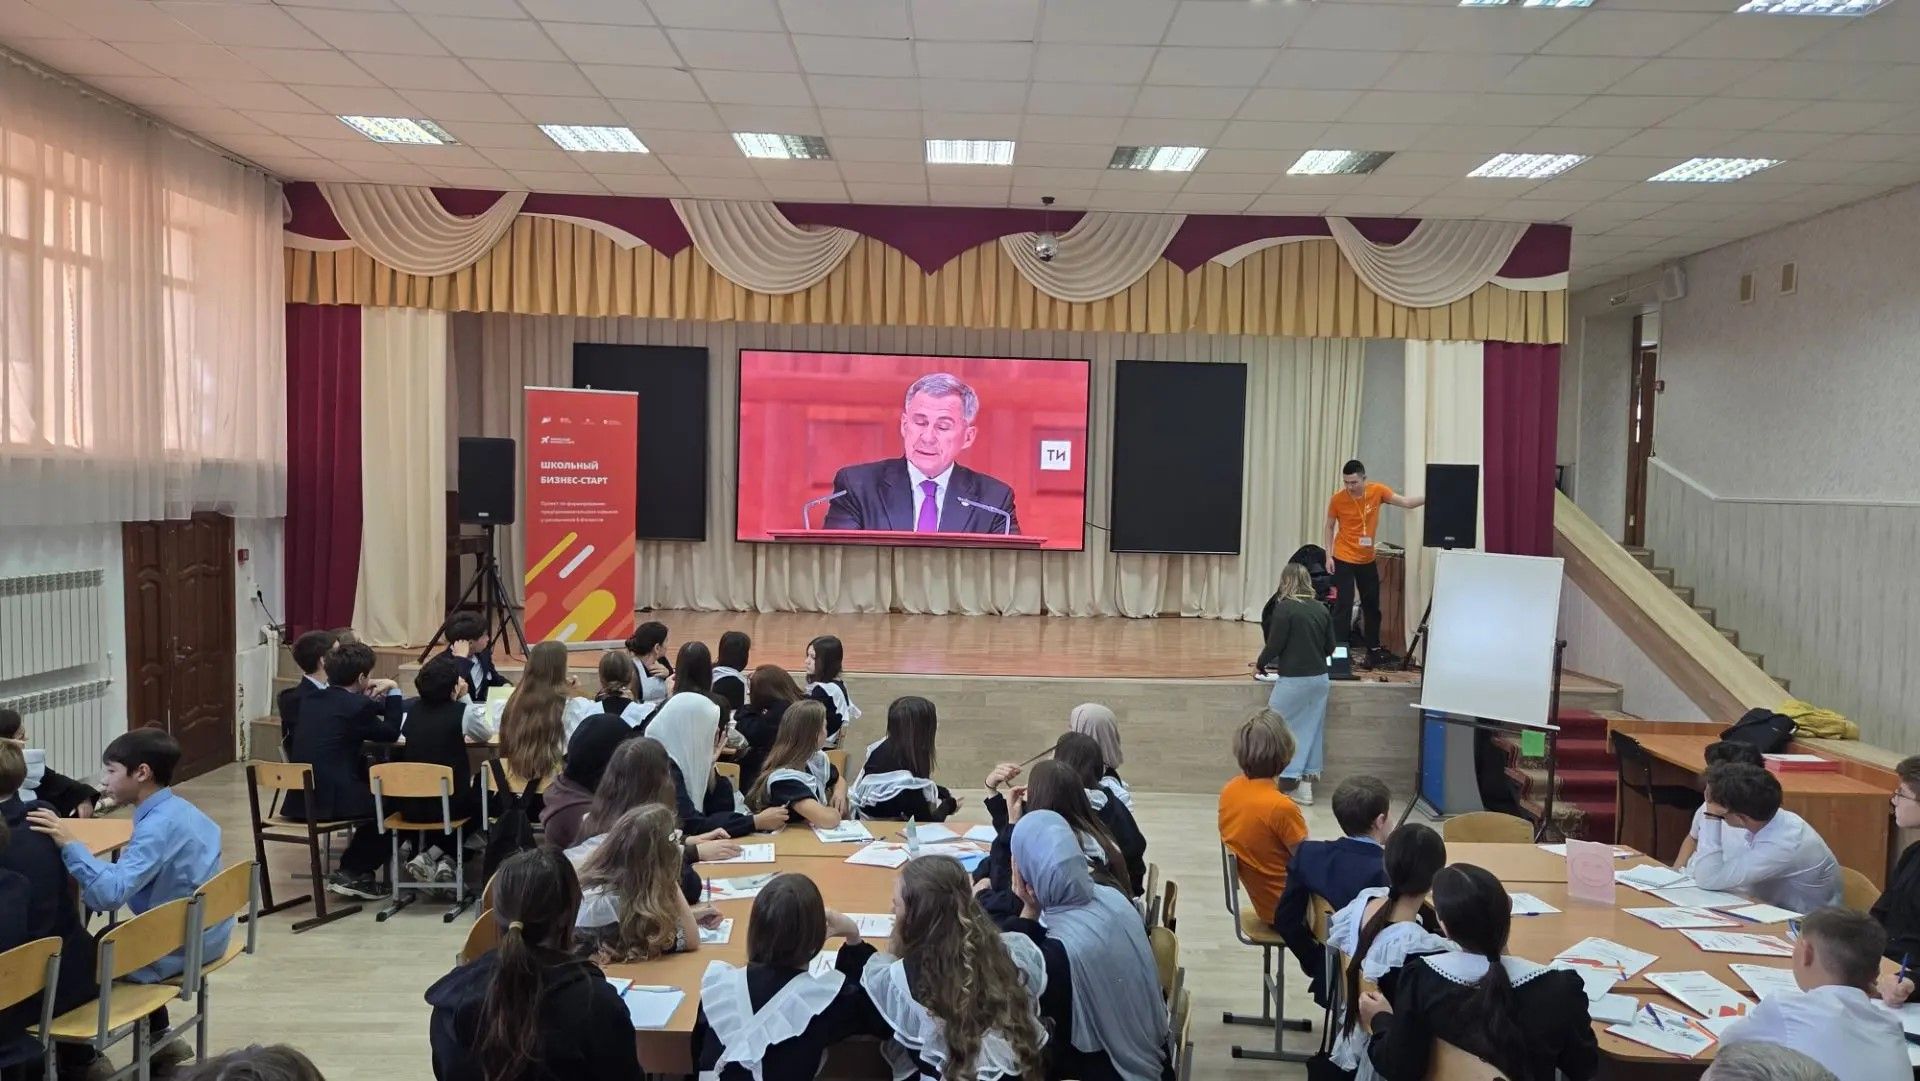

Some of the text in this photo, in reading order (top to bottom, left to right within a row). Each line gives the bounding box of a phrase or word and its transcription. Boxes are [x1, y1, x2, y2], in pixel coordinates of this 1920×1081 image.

[1047, 449, 1066, 462] ТИ
[540, 460, 599, 470] ШКОЛЬНЫЙ
[540, 476, 609, 485] БИЗНЕС-СТАРТ
